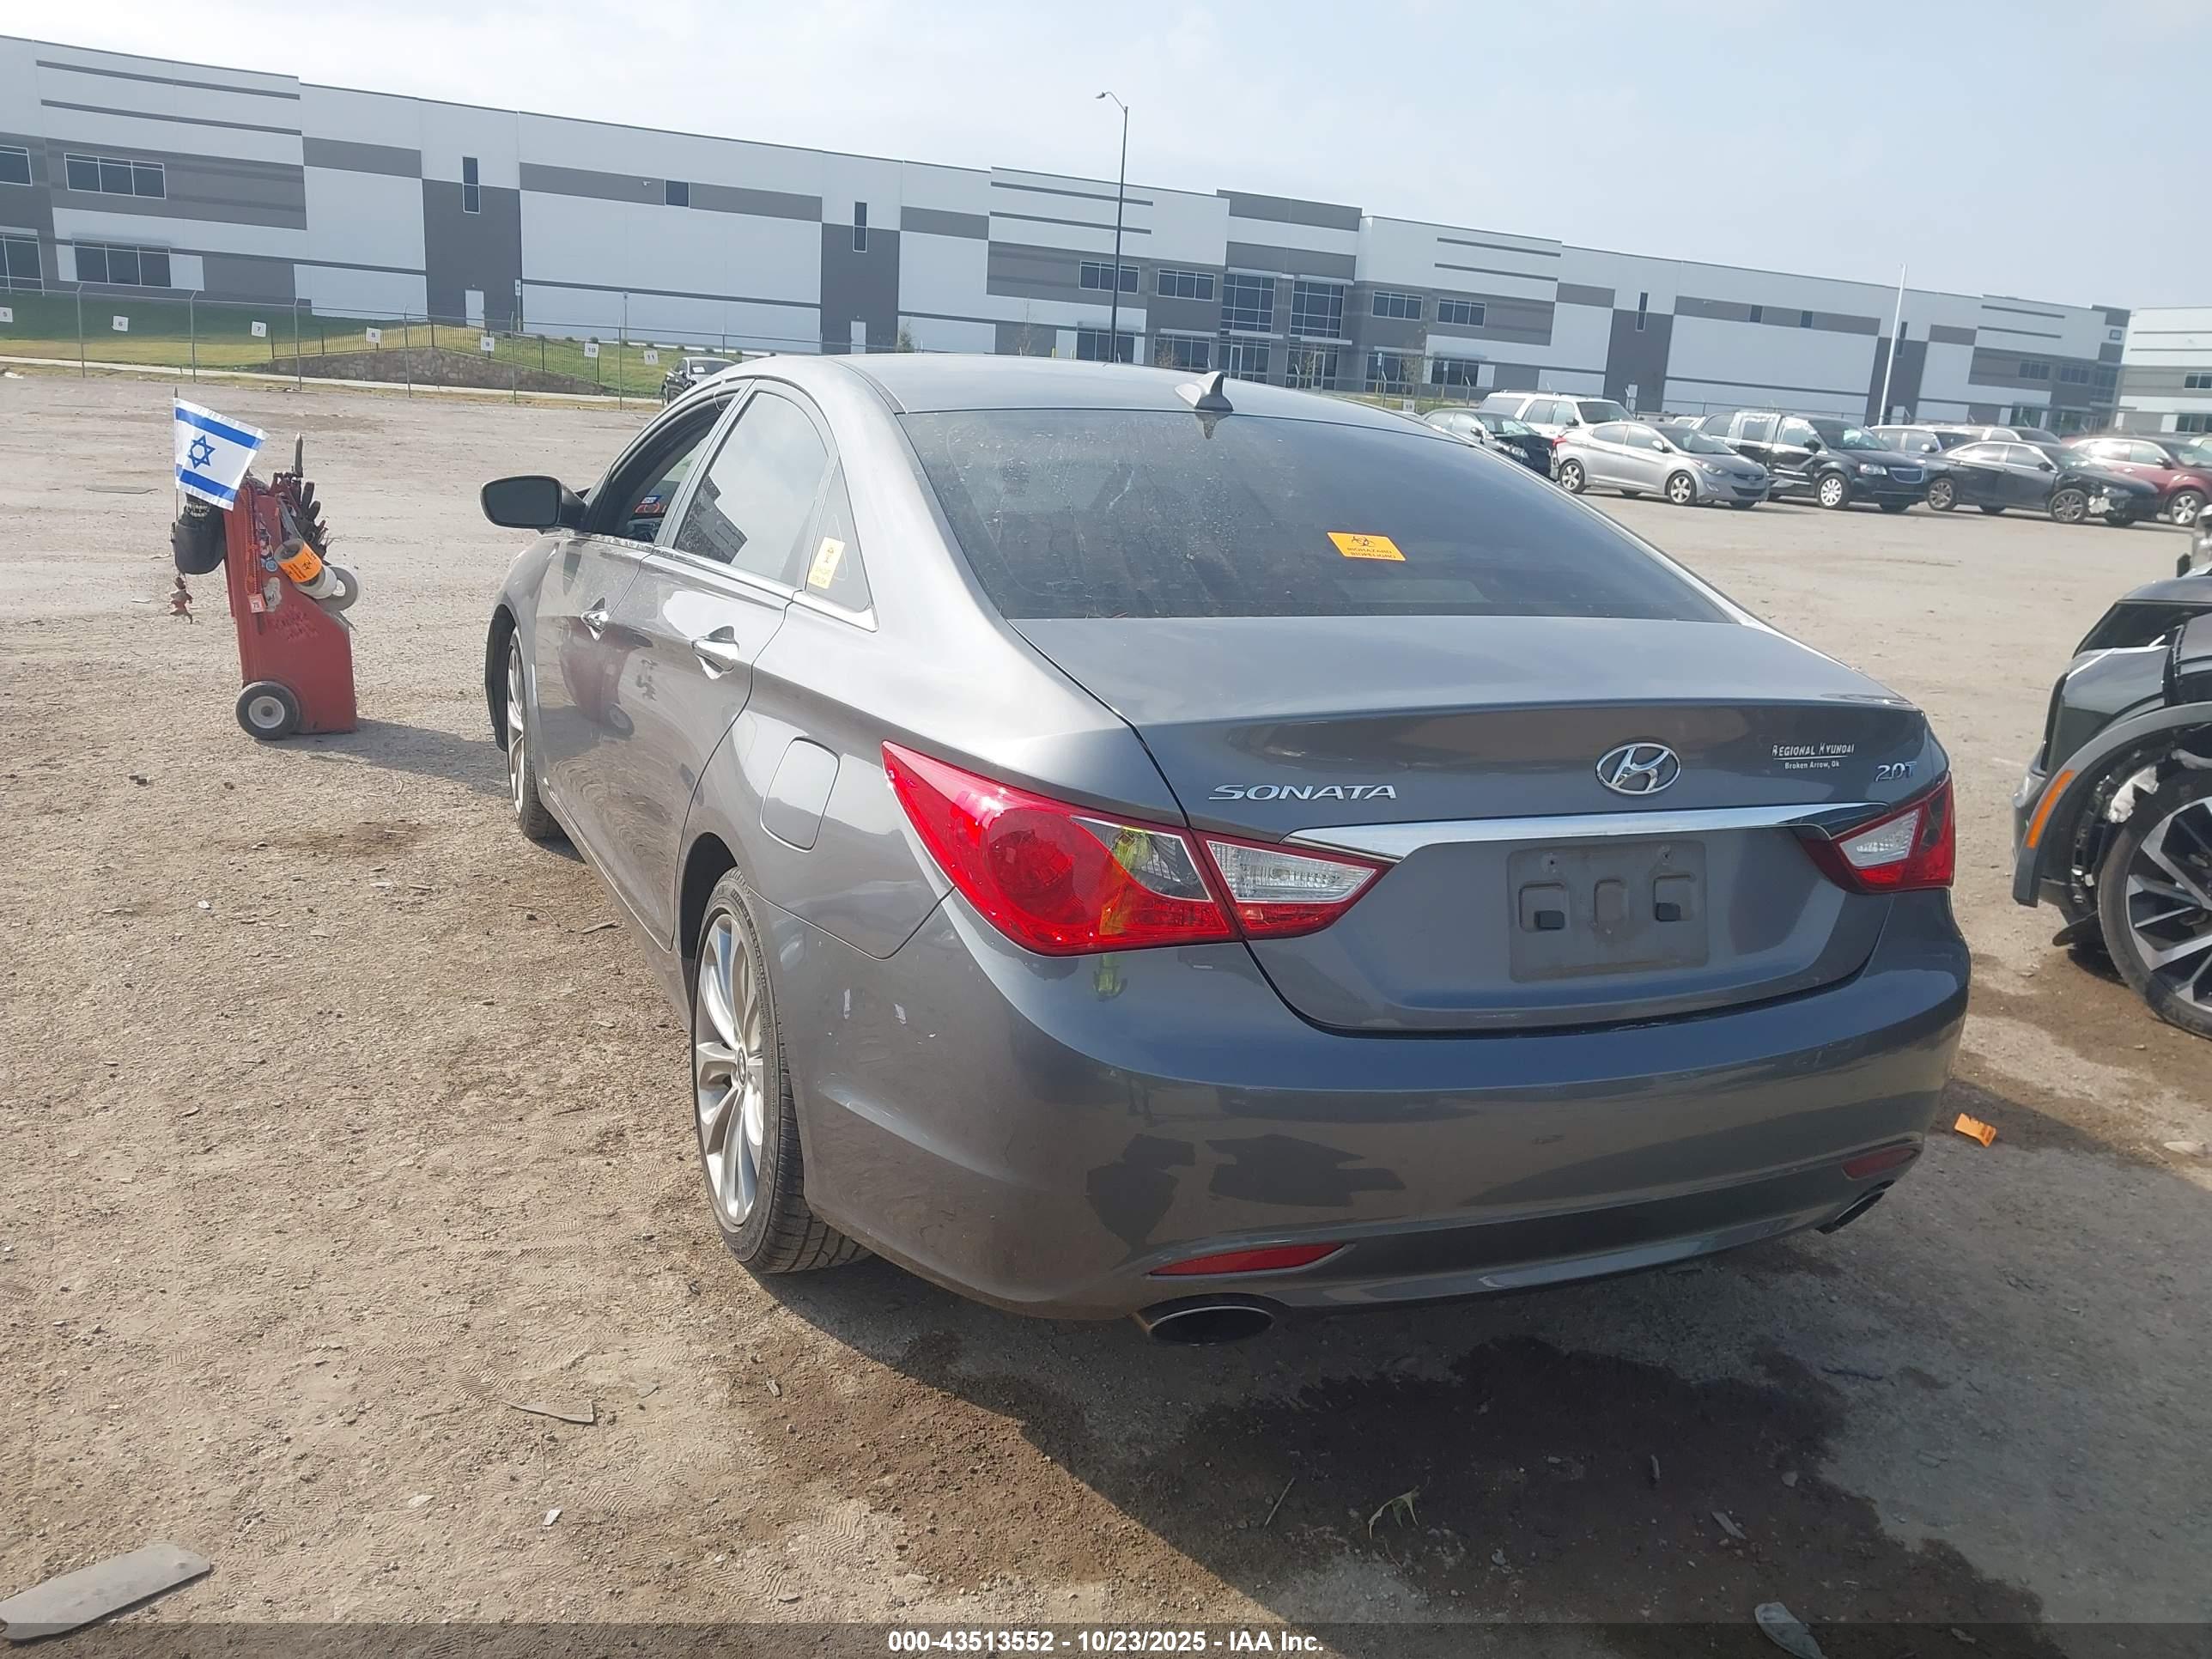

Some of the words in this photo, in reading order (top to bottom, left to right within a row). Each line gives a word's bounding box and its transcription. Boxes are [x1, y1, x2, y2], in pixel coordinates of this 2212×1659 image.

[1771, 744, 1815, 757] REGIONAL
[1784, 761, 1808, 770] Broken
[1809, 760, 1831, 769] Arrow,
[1208, 783, 1397, 801] SONATA
